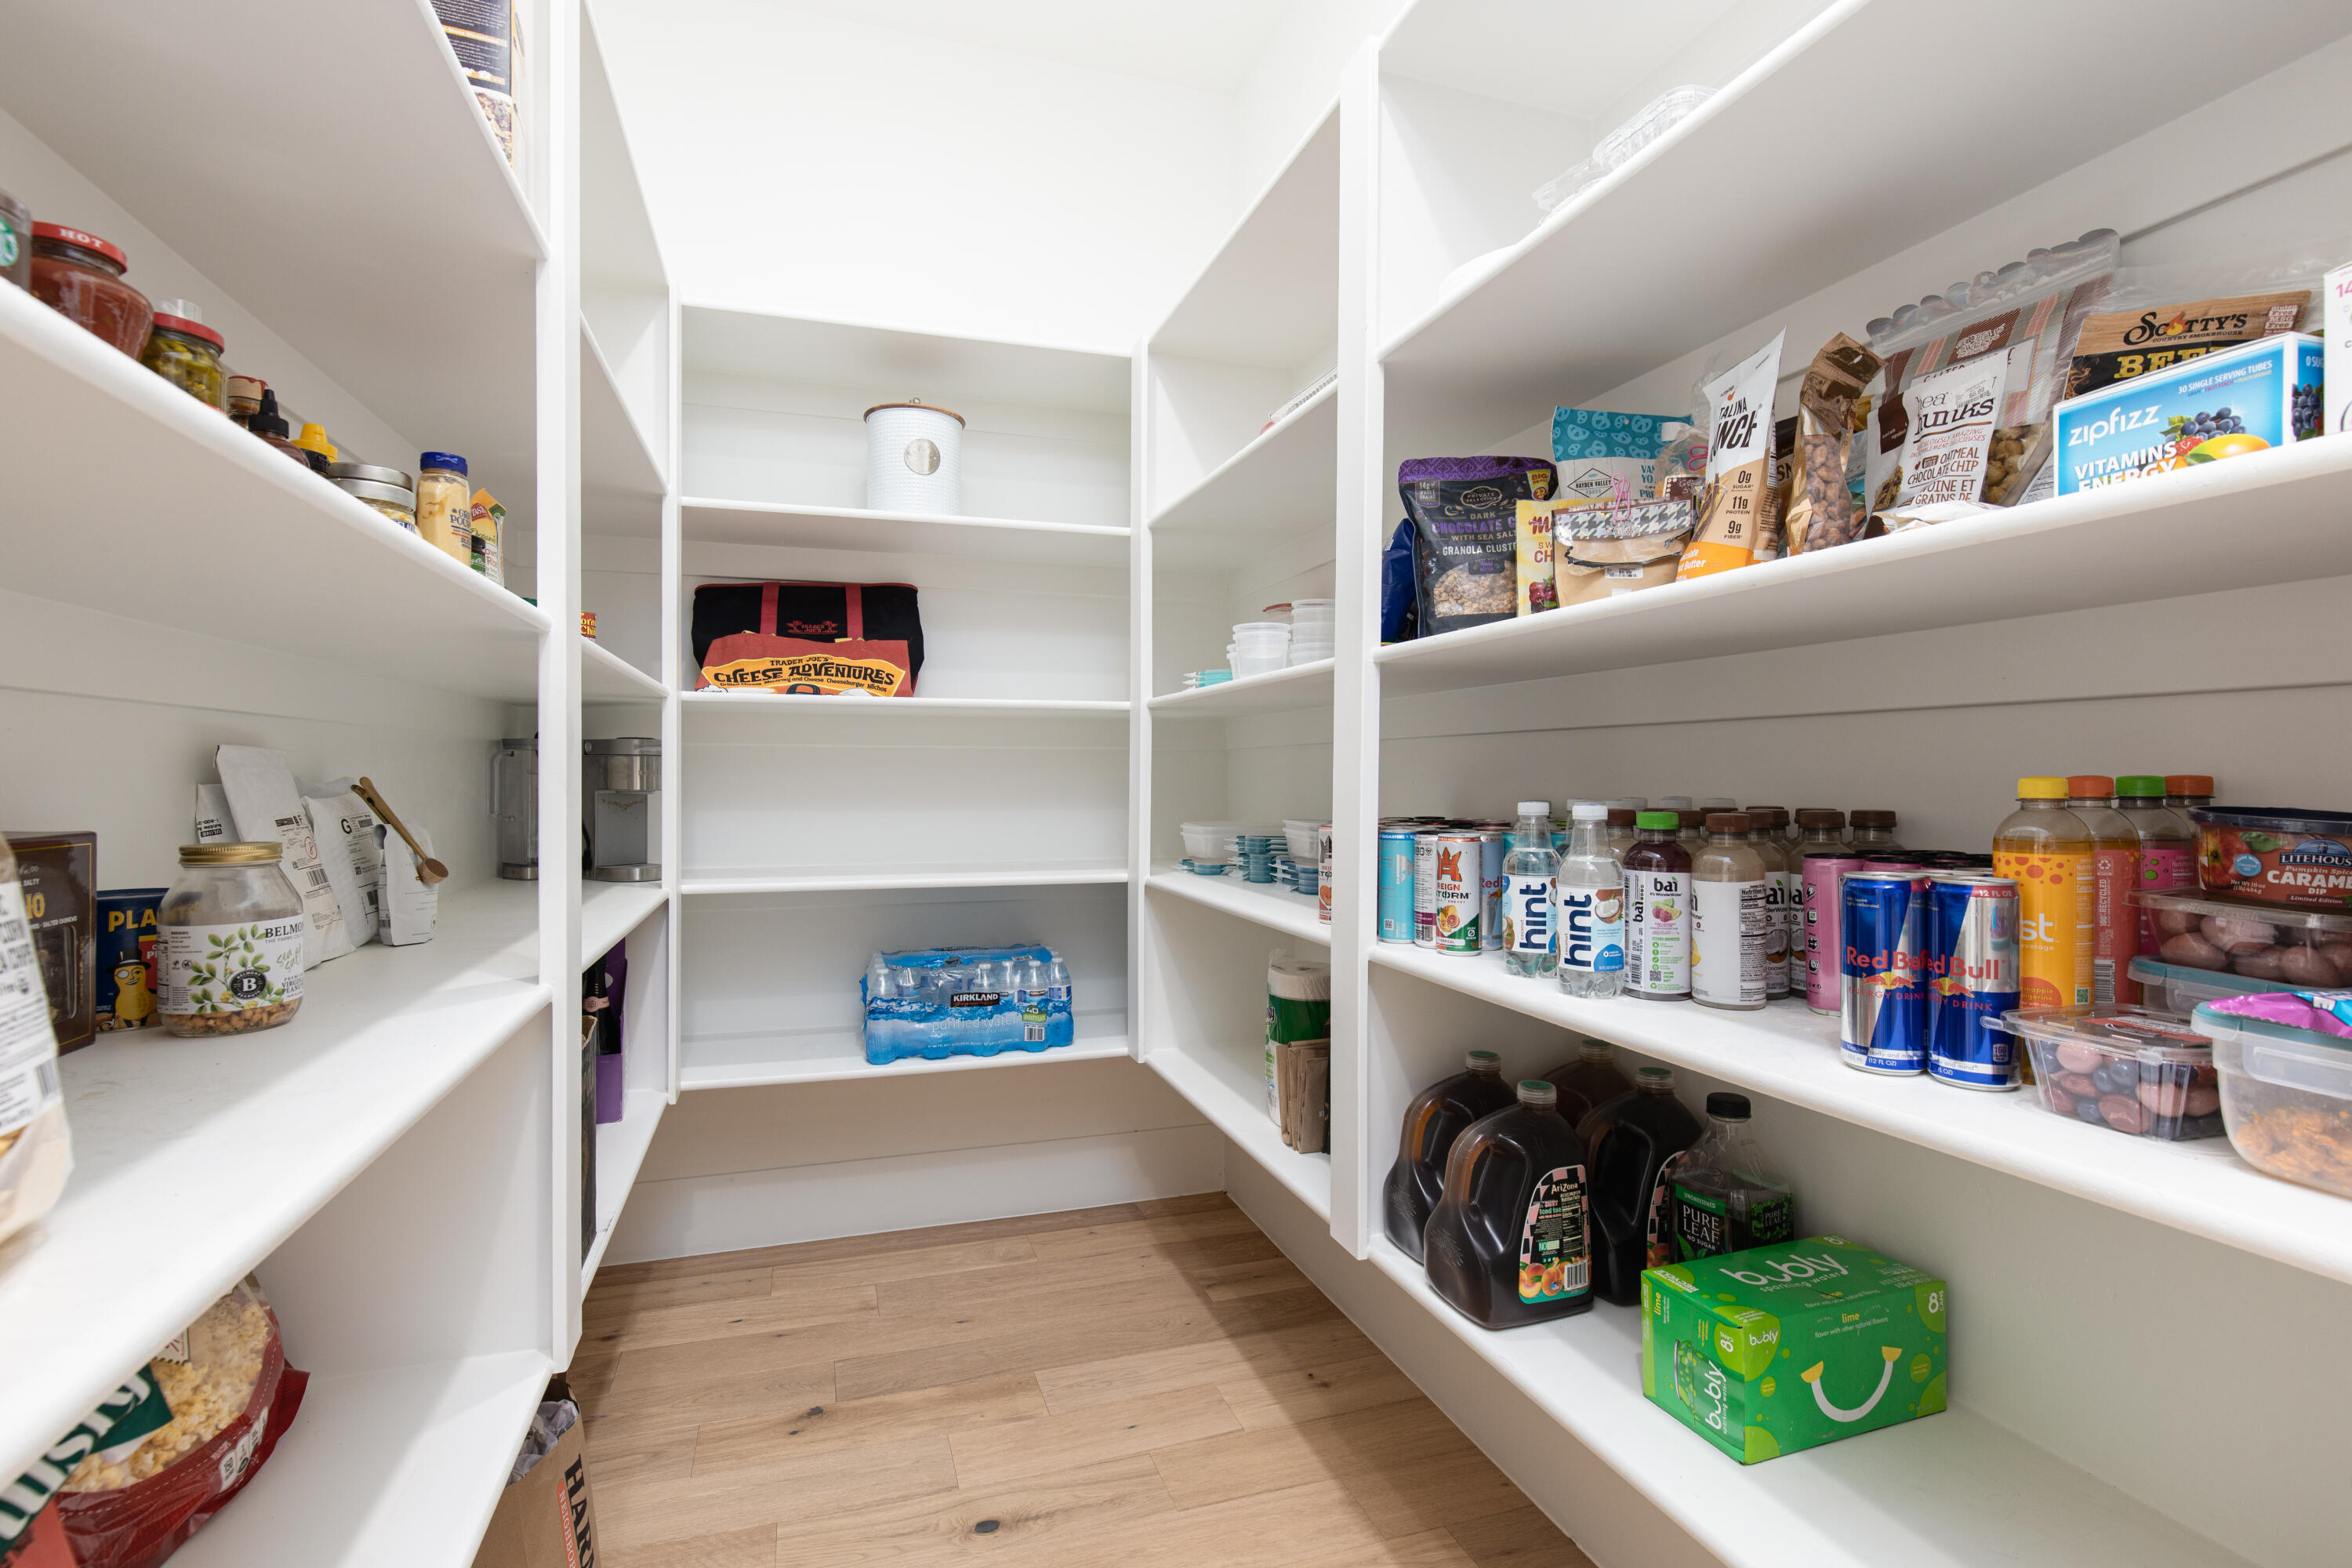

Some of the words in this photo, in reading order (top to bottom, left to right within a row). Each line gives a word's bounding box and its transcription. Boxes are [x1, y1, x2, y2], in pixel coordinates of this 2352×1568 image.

[59, 227, 103, 248] HOT
[2153, 334, 2187, 343] COUNTRY
[2189, 330, 2243, 339] SMOKEHOUSE
[2178, 385, 2187, 394] 30
[2188, 378, 2214, 393] SINGLE
[2215, 368, 2247, 383] SERVING
[2248, 360, 2274, 374] TUBES
[2067, 405, 2161, 447] zipfizz
[1940, 447, 1980, 464] OATMEAL
[2074, 441, 2178, 480] VITAMINS
[1738, 470, 1751, 484] 0g
[1907, 463, 1950, 485] CHOCOLATE
[1950, 460, 1979, 472] CHIP
[1419, 481, 1431, 490] 14g
[1961, 480, 1976, 492] ET
[1733, 495, 1748, 510] 11g
[1432, 519, 1503, 534] CHOCOLATE
[1728, 520, 1741, 534] 9g
[1443, 545, 1483, 557] GRANOLA
[713, 667, 783, 684] CHEESE
[789, 662, 895, 686] ADVENTURES
[826, 677, 866, 689] Cheeseburger
[341, 818, 352, 835] G
[2285, 865, 2328, 874] Pumpkin
[1653, 877, 1679, 893] bai
[2099, 879, 2107, 913] RECYCLED
[1519, 882, 1547, 949] hint
[1632, 901, 1644, 923] bai
[42, 919, 59, 927] SALTED
[1563, 894, 1592, 967] hint
[276, 948, 292, 964] sea
[1846, 946, 1889, 970] Red
[236, 971, 261, 979] BELMONT
[1949, 956, 1999, 980] Bull
[242, 978, 257, 992] B
[1849, 986, 1891, 1000] ENERGY
[953, 993, 999, 1002] KIRKLAND
[1952, 997, 1993, 1011] DRINK
[932, 1016, 981, 1033] purified
[982, 1015, 1016, 1028] water
[1869, 1049, 1886, 1058] body
[1551, 1182, 1578, 1195] AriZona
[1684, 1192, 1716, 1210] UNSWEETENED
[1682, 1204, 1719, 1231] PURE
[1765, 1210, 1782, 1220] PURE
[1683, 1218, 1719, 1244] LEAF
[1539, 1242, 1547, 1251] NO
[1697, 1239, 1716, 1251] SUGAR
[1719, 1254, 1849, 1286] bubly
[1760, 1277, 1811, 1293] sparkling
[1811, 1272, 1841, 1283] water
[1928, 1292, 1940, 1314] 8
[1842, 1312, 1860, 1323] lime
[1814, 1330, 1829, 1338] flavor
[1830, 1327, 1841, 1335] with
[1855, 1320, 1871, 1330] natural
[1872, 1316, 1889, 1326] flavors
[1720, 1338, 1734, 1353] 8
[1749, 1330, 1779, 1347] bubly
[1704, 1360, 1727, 1431] bubly
